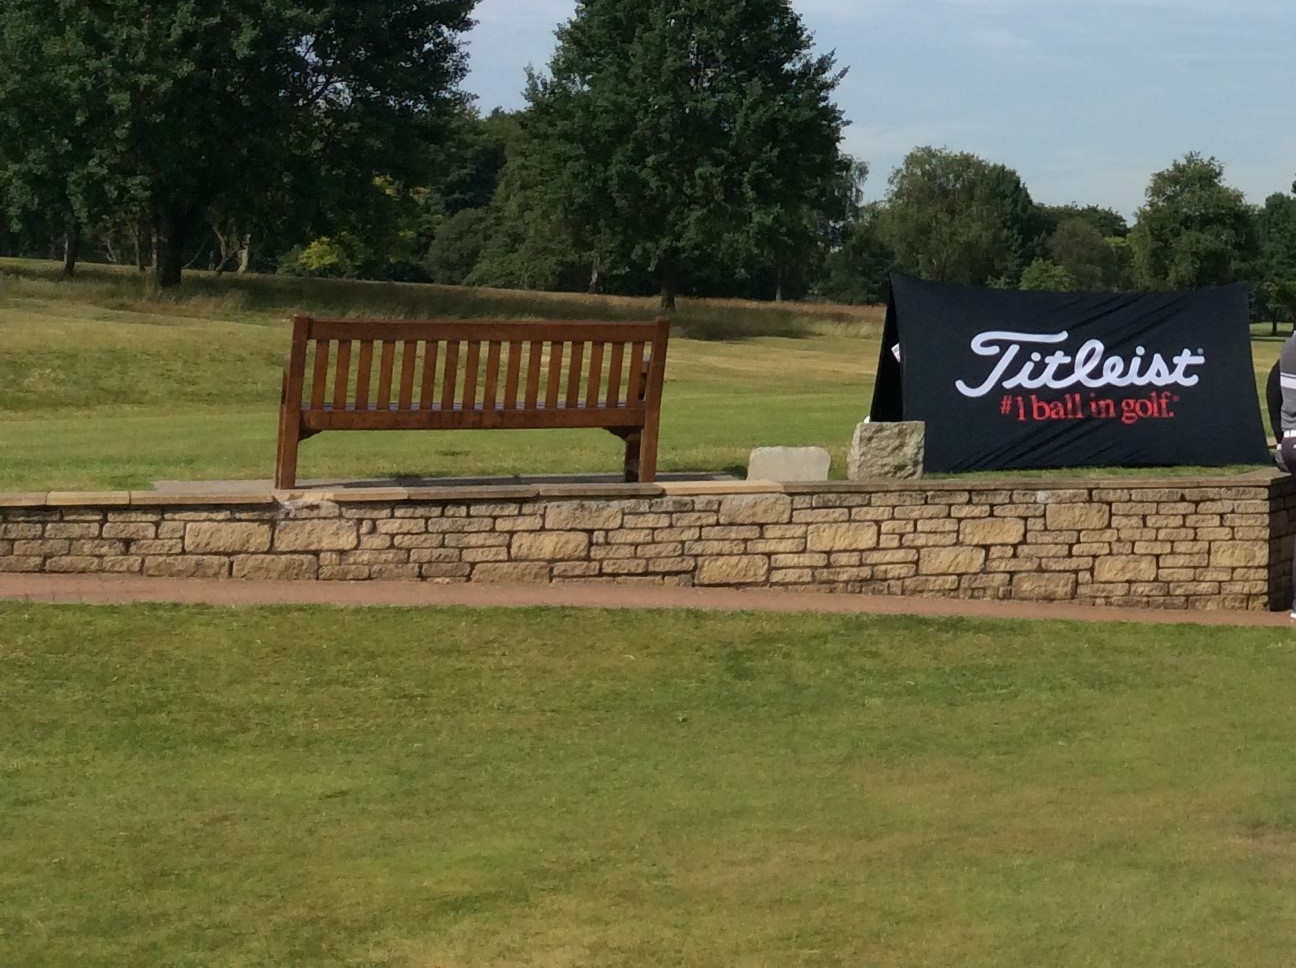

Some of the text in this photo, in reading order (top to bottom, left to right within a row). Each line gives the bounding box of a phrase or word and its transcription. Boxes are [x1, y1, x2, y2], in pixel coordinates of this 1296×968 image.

[955, 330, 1206, 398] Titleist
[1030, 392, 1083, 421] ball
[1089, 392, 1116, 419] in
